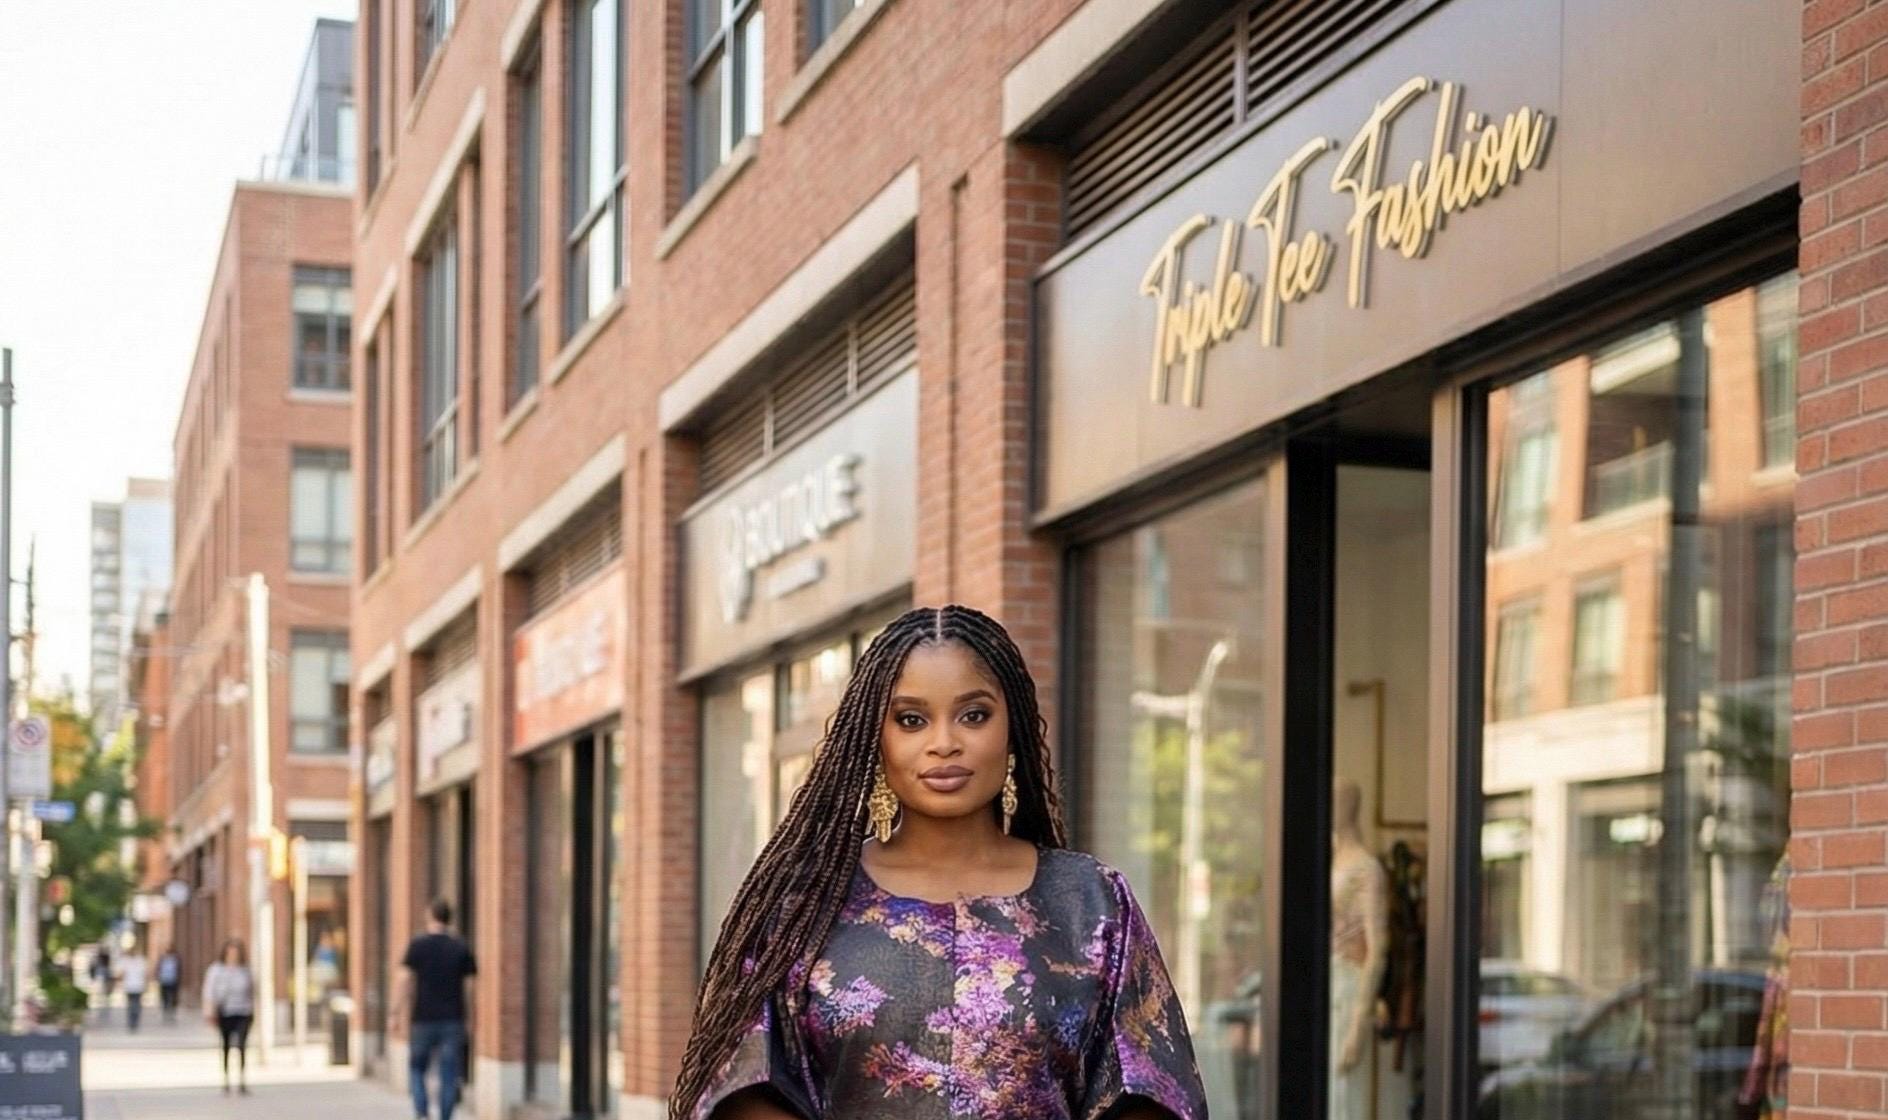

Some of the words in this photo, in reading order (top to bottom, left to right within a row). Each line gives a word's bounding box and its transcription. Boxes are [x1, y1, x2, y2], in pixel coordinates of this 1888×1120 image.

[1140, 213, 1253, 407] Triple
[1247, 136, 1332, 347] Tee
[1330, 76, 1547, 309] Fashion
